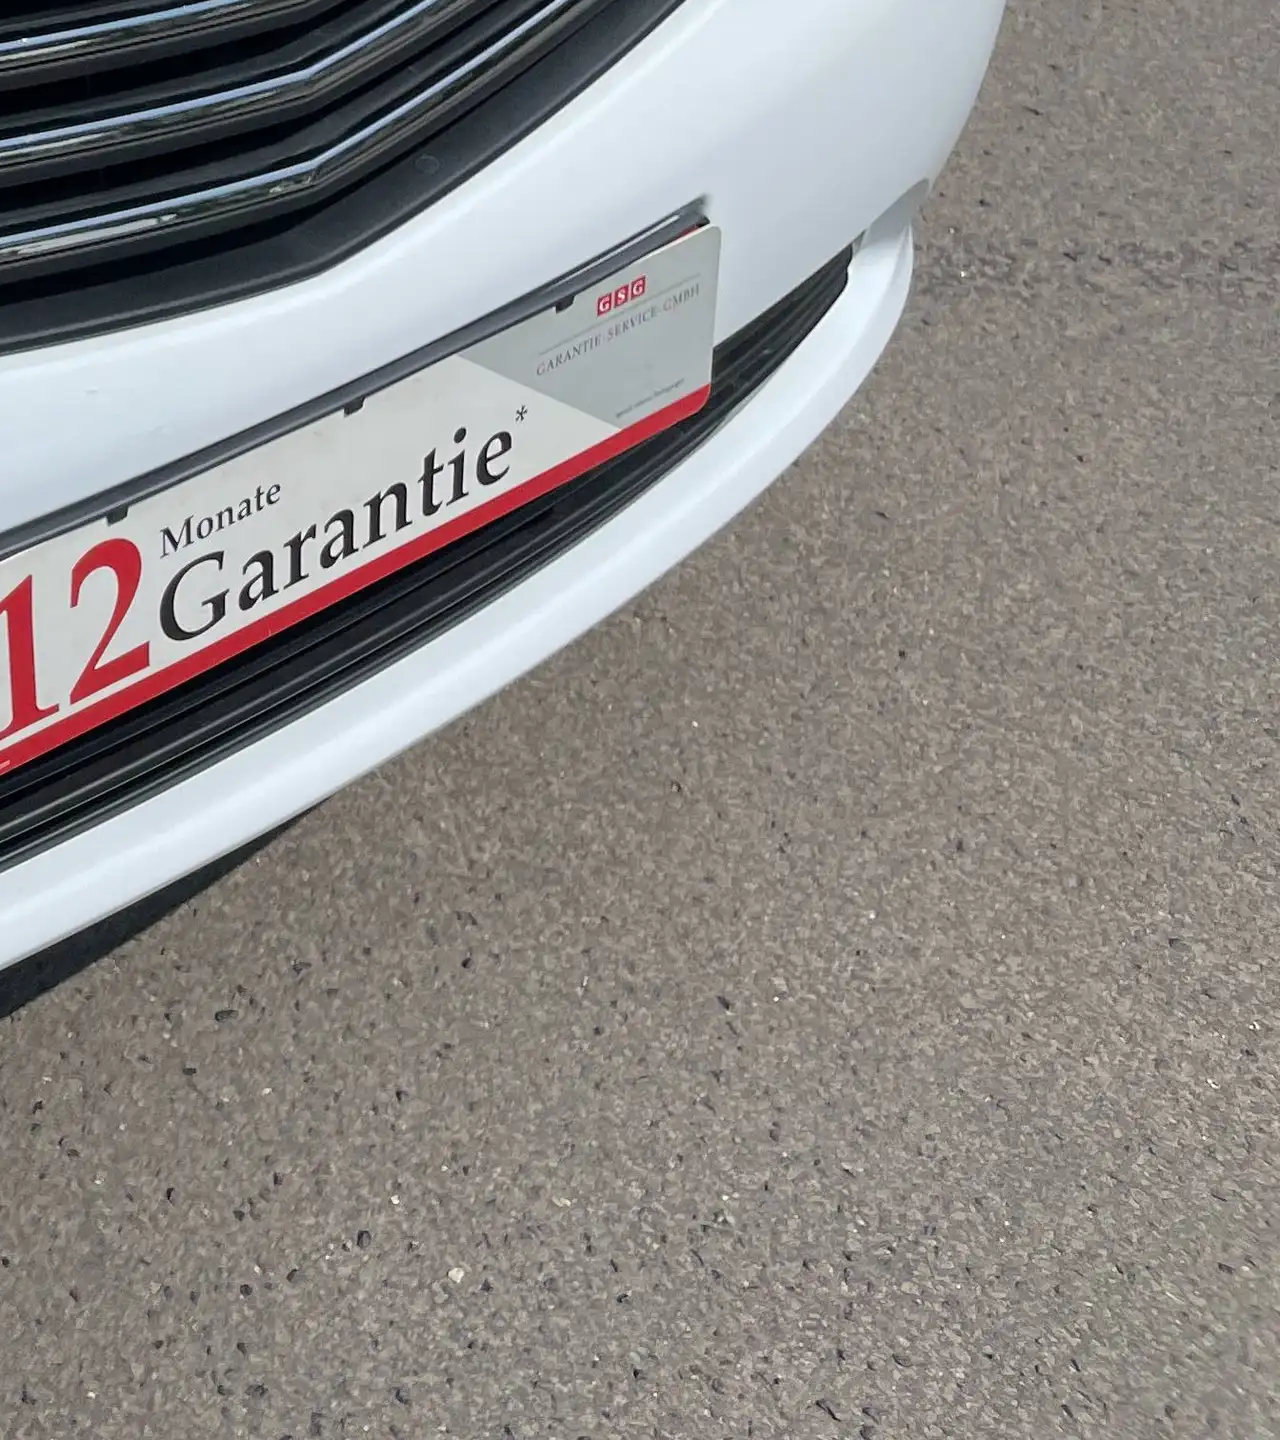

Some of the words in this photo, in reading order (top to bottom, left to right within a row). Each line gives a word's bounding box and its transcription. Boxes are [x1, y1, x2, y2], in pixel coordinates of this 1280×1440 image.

[597, 276, 646, 316] GSG
[536, 333, 602, 376] GARANTIE
[606, 306, 658, 342] SERVICE
[159, 482, 282, 558] Monate
